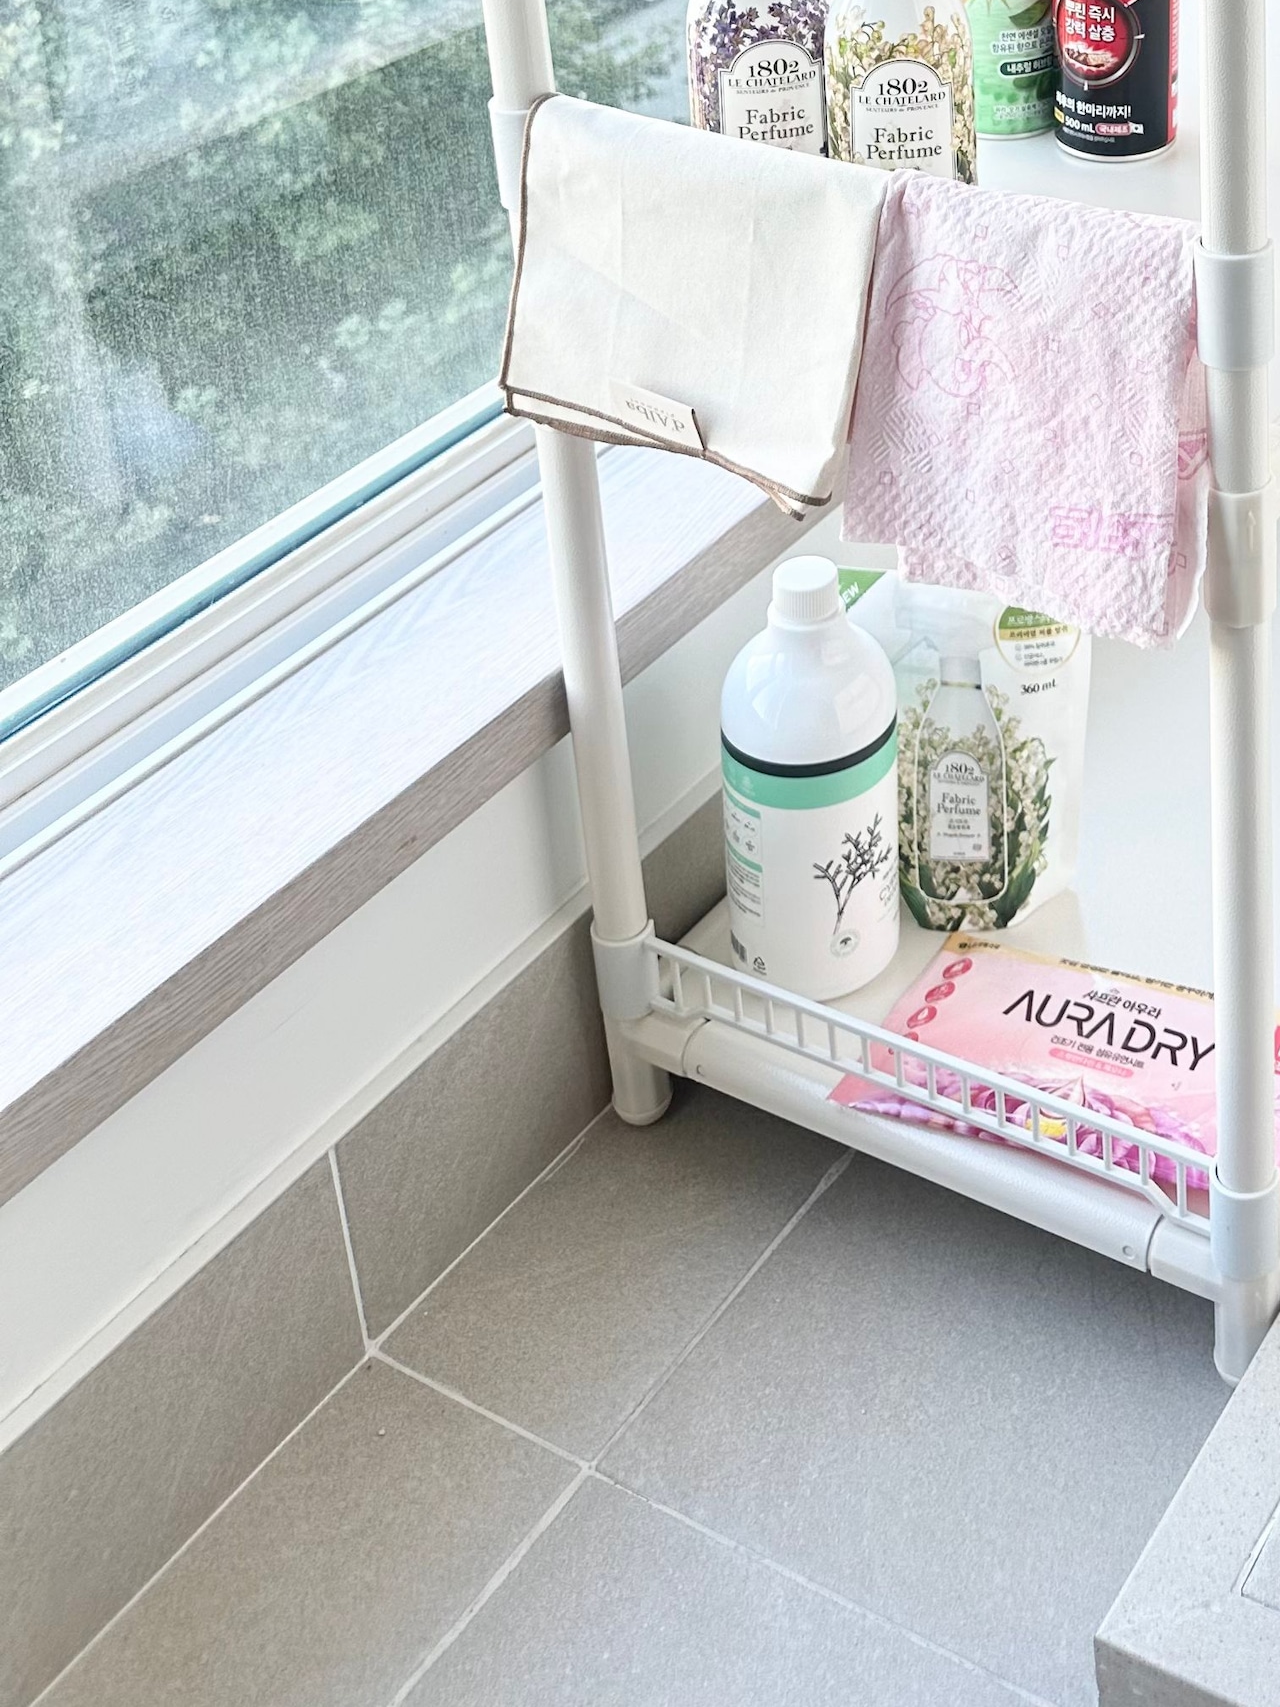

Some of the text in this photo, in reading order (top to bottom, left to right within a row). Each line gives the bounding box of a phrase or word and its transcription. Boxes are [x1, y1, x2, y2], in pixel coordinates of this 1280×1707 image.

[1088, 4, 1115, 24] 즉시
[1001, 32, 1017, 42] 천연
[1065, 16, 1115, 42] 강력 살충
[749, 58, 799, 78] 1802
[728, 69, 816, 88] LE CHATELARD
[878, 78, 928, 95] 1802
[859, 91, 946, 106] LE CHATELARD
[745, 106, 805, 125] Fabric
[1076, 100, 1131, 119] 한마리까지!
[1065, 115, 1080, 130] 500
[738, 122, 814, 141] Perfume
[874, 127, 933, 144] Fabric
[866, 143, 942, 161] Perfume
[1021, 683, 1040, 695] 360
[945, 763, 974, 775] 1802
[942, 793, 976, 805] Fabric
[937, 803, 981, 815] Perfume
[1123, 1000, 1162, 1019] 아우라
